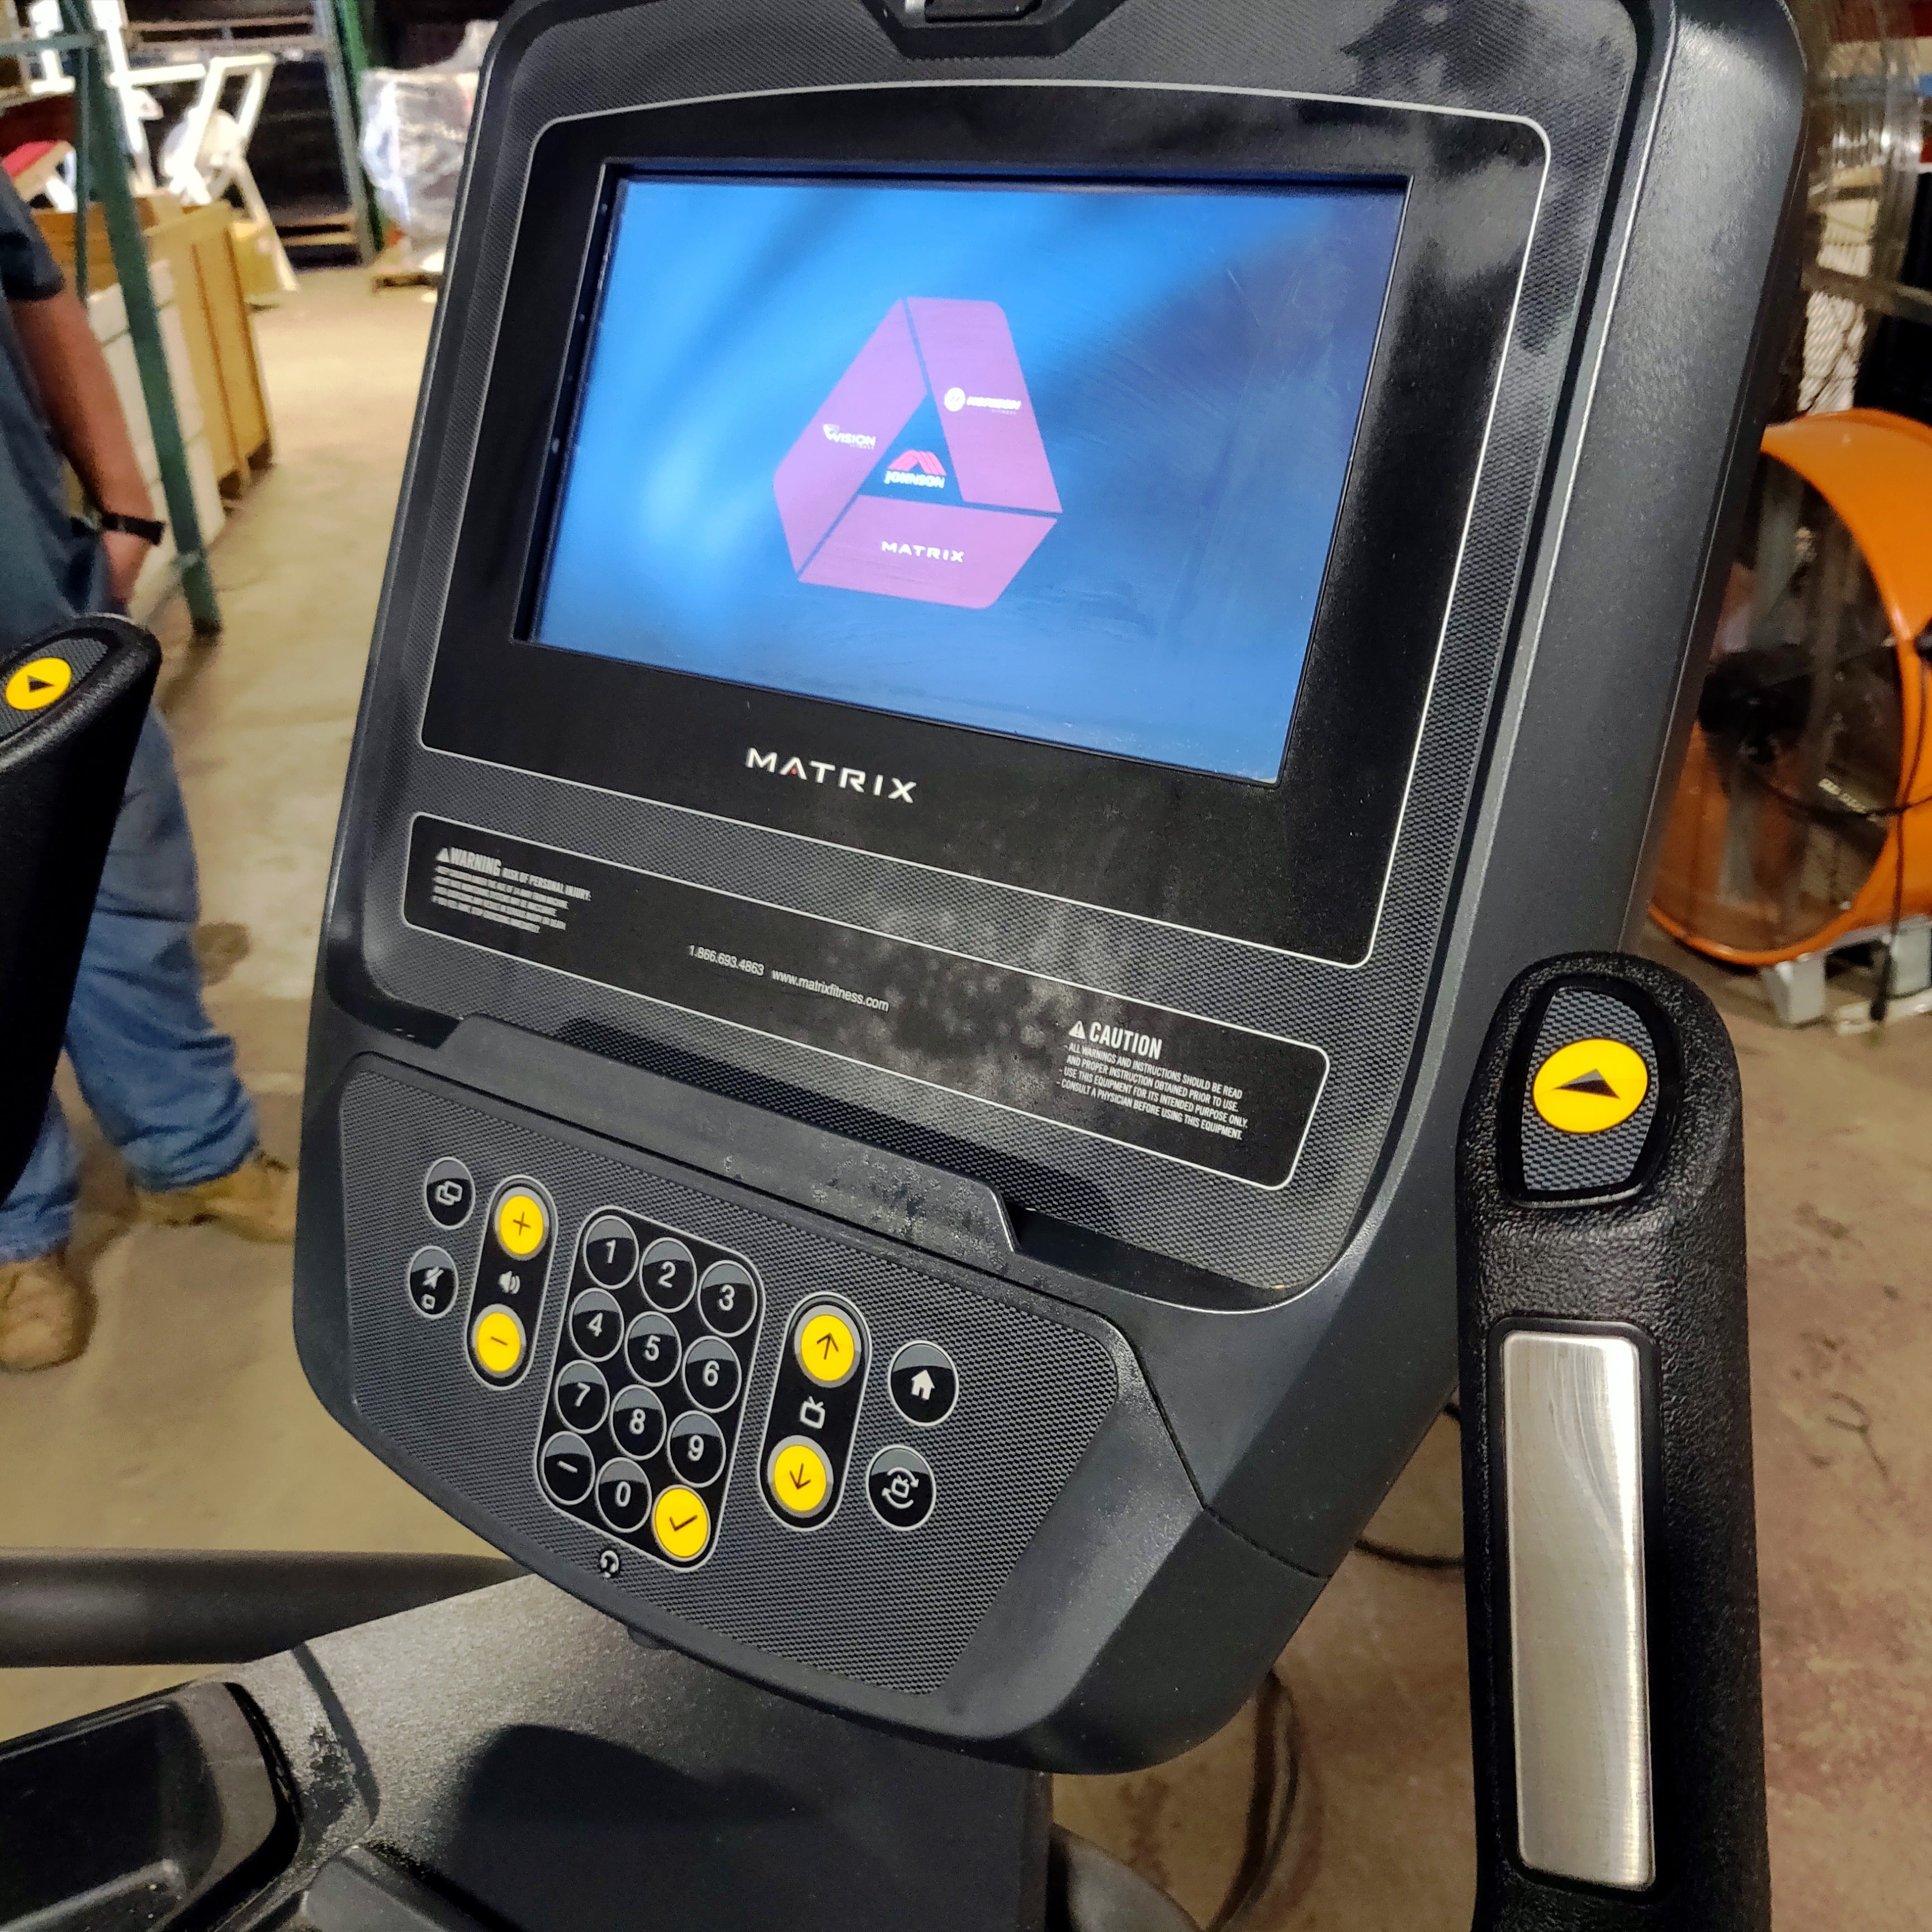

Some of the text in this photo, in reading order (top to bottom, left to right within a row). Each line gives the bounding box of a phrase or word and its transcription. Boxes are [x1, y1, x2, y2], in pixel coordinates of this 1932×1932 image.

[881, 540, 965, 563] MATRIX
[746, 747, 917, 803] MATRIX
[450, 846, 501, 876] WARNING
[529, 874, 565, 894] PERSONAL
[689, 944, 889, 1012] 1.866.693.4863 www.matrixfitness.com
[1089, 1021, 1163, 1060] CAUTION
[1067, 1055, 1239, 1112] AND PROPER INSTRUCTION OBTAINED PRIOR TO USE.
[1068, 1042, 1081, 1054] ALL
[1082, 1045, 1116, 1064] WARNINGS
[1116, 1055, 1131, 1068] AND
[1132, 1060, 1182, 1082] INSTRUCTIONS
[1182, 1073, 1211, 1090] SHOULD
[1211, 1082, 1222, 1094] BE
[1223, 1085, 1243, 1100] READ
[1062, 1078, 1091, 1095] CONSULT
[1091, 1087, 1096, 1098] A
[1097, 1089, 1133, 1108] PHYSICIAN
[1133, 1100, 1161, 1116] BEFORE
[1161, 1107, 1183, 1123] USING
[1184, 1114, 1200, 1128] THIS
[1200, 1119, 1243, 1140] EQUIPMENT.
[1064, 1066, 1078, 1078] USE
[1078, 1070, 1093, 1083] THIS
[1093, 1074, 1133, 1094] EQUIPMENT
[1133, 1086, 1147, 1098] FOR
[1147, 1091, 1159, 1102] ITS
[1159, 1093, 1194, 1112] INTENDED
[1195, 1104, 1228, 1123] PURPOSE
[1229, 1114, 1248, 1128] ONLY.
[606, 1239, 616, 1264] 1
[658, 1261, 676, 1288] 2
[718, 1284, 735, 1311] 3
[588, 1313, 603, 1337] 4
[645, 1334, 661, 1361] 5
[703, 1360, 720, 1387] 6
[575, 1381, 591, 1407] 7
[629, 1408, 646, 1435] 8
[688, 1434, 704, 1461] 9
[615, 1481, 632, 1507] 0
